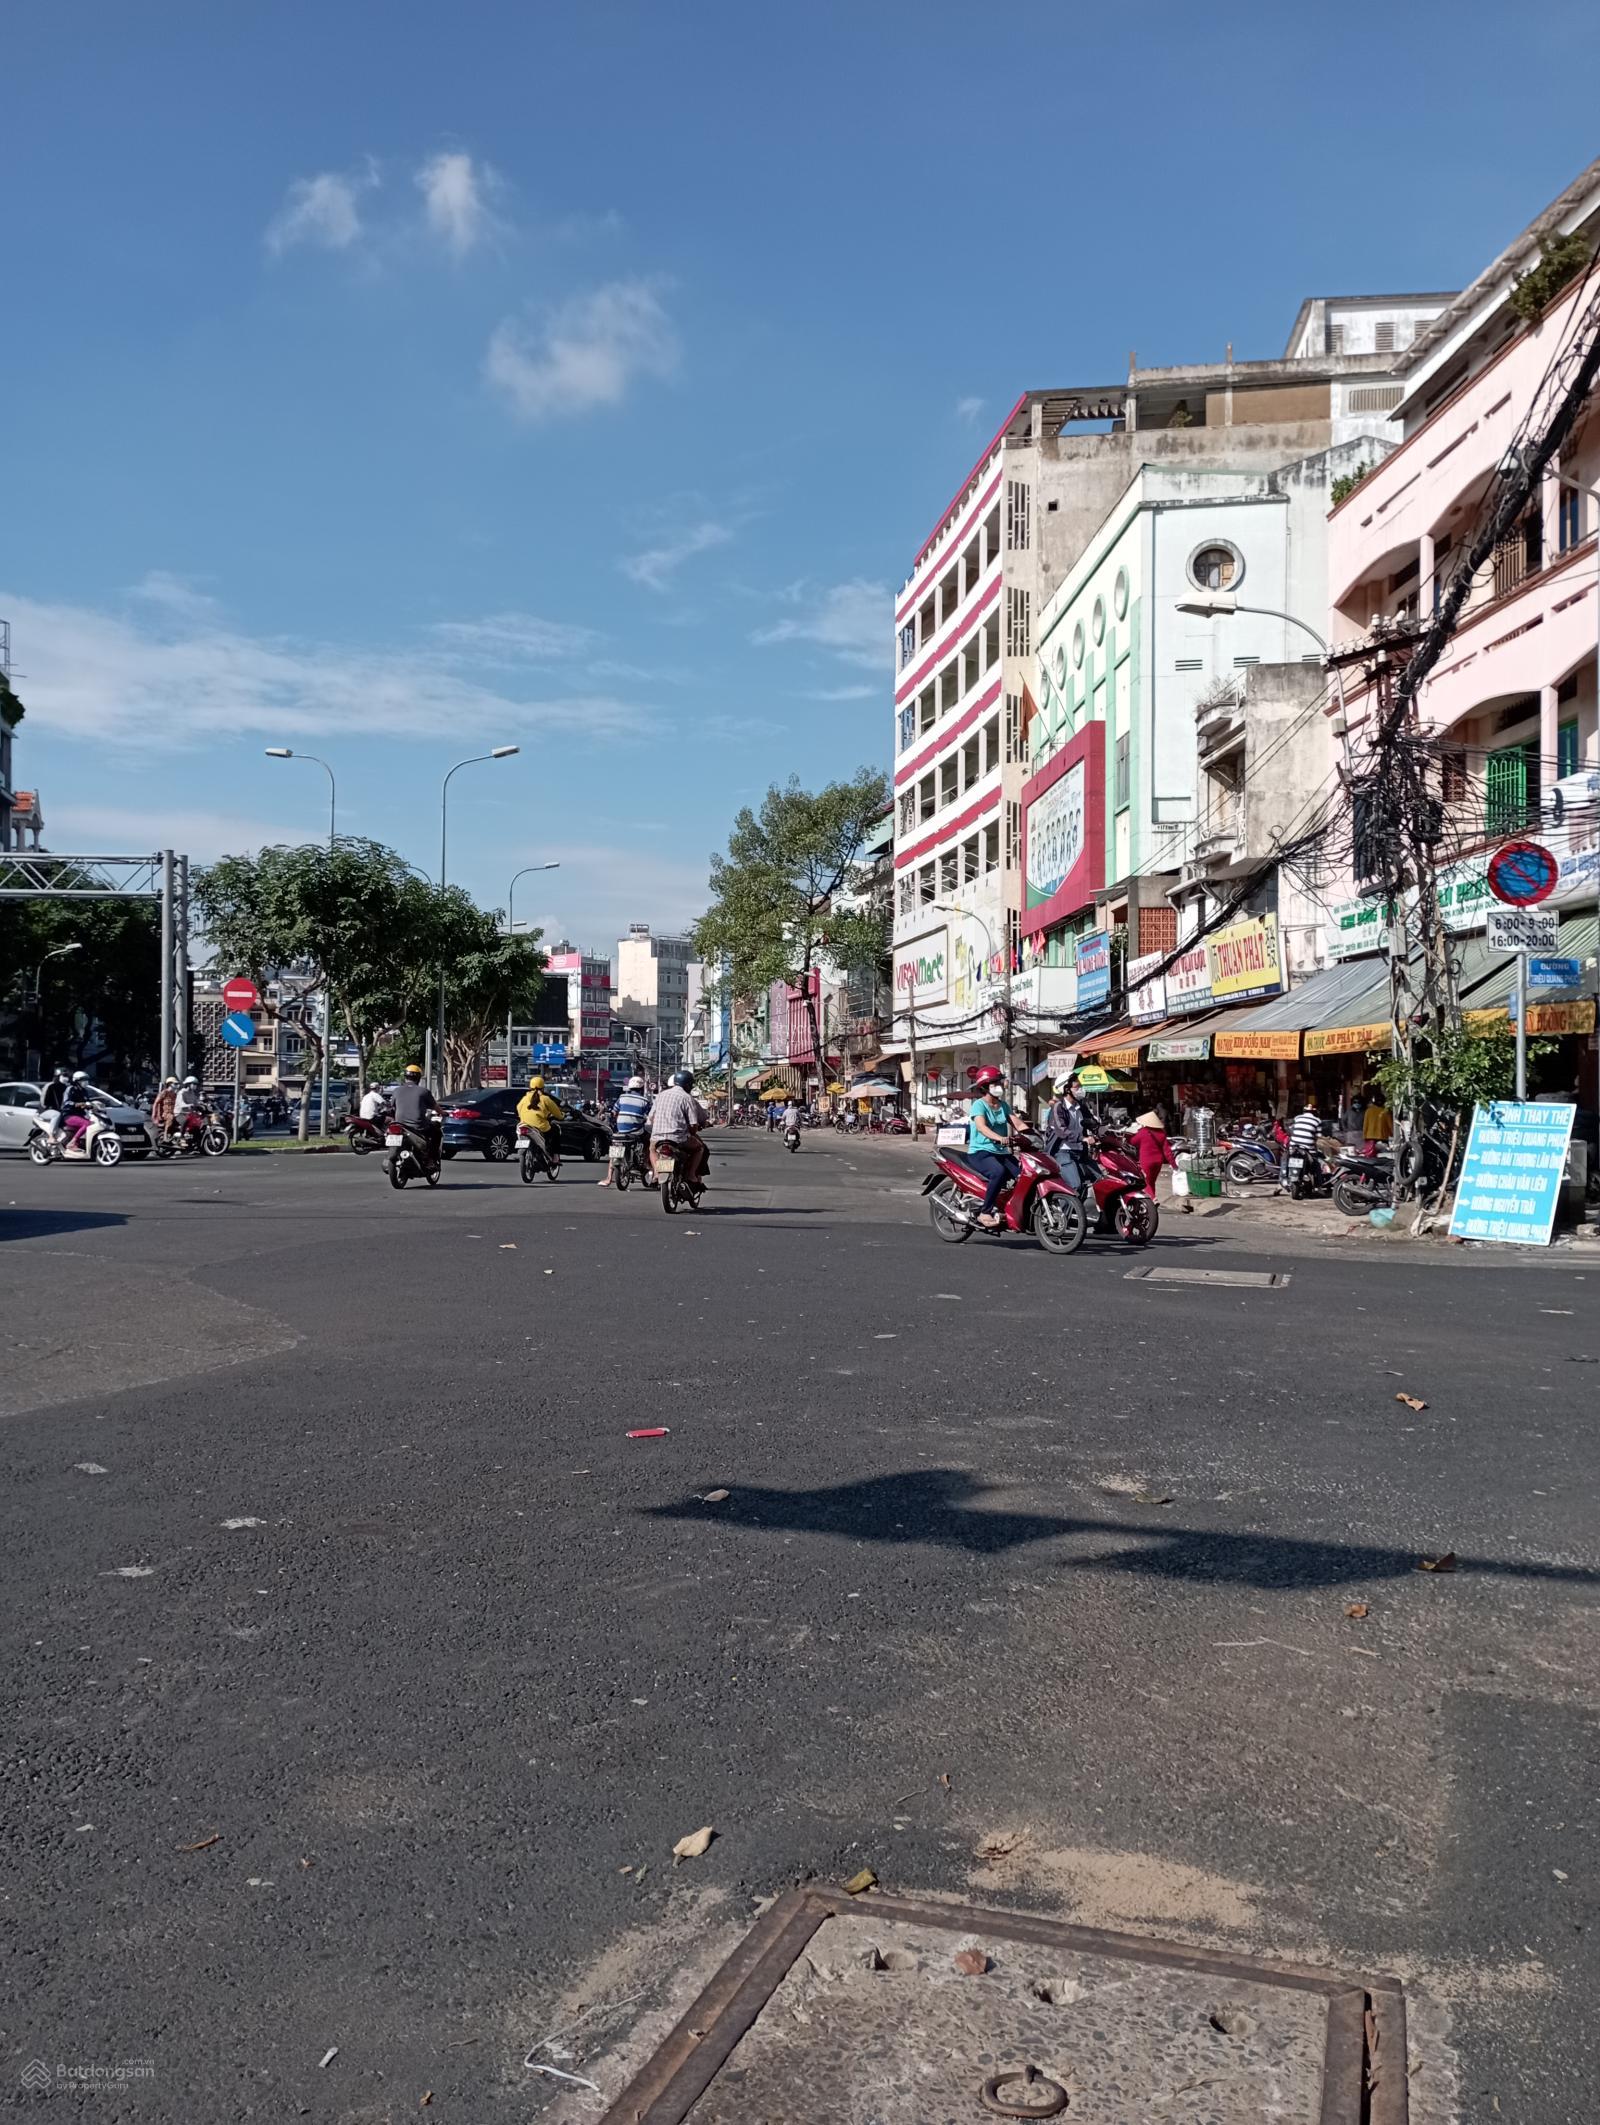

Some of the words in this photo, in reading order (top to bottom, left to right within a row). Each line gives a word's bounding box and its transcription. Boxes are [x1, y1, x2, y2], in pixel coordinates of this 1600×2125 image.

[1243, 923, 1264, 973] PHÁT
[1524, 1108, 1549, 1124] THAY
[1551, 1107, 1571, 1125] THẾ
[1522, 1131, 1547, 1146] QUANG
